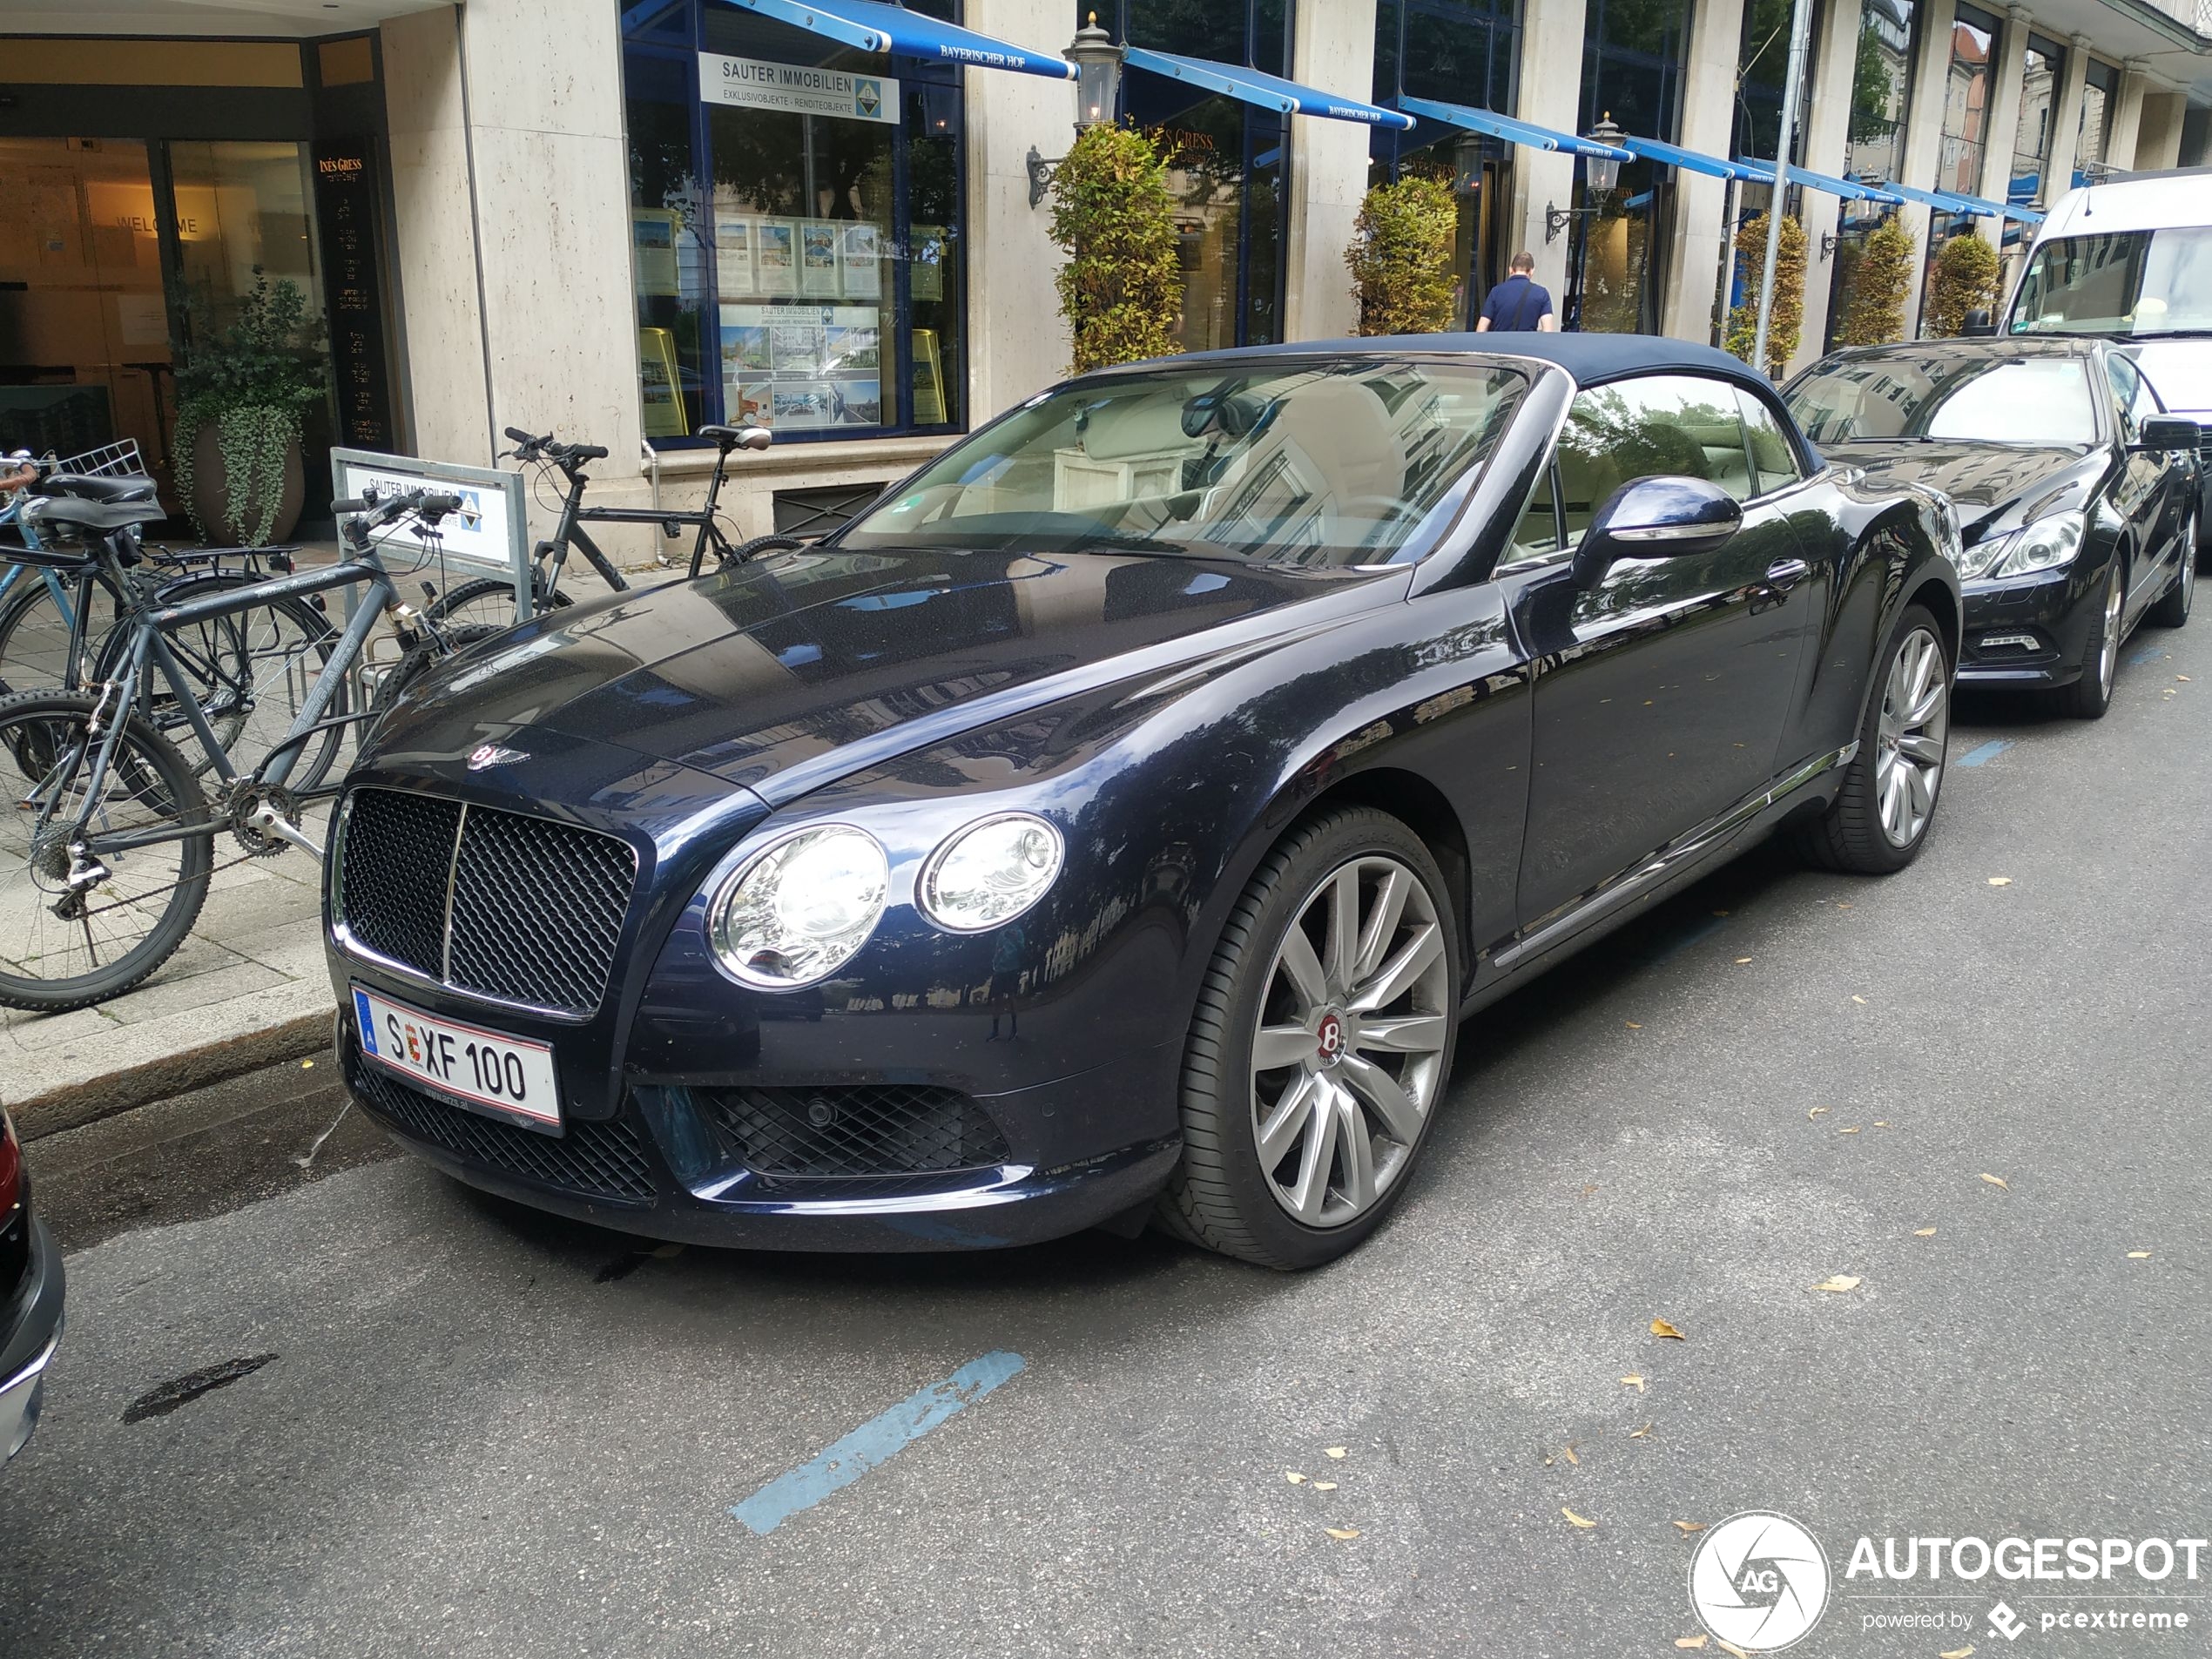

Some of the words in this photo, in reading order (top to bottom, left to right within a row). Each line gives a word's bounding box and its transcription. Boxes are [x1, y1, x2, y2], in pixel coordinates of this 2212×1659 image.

[940, 44, 1005, 65] BAYERISCHER
[1007, 56, 1026, 68] HOF
[723, 62, 775, 84] SAUTER
[779, 70, 852, 92] IMMOBILIEN
[723, 90, 788, 106] EXKLUSIVOBJEKTE
[794, 98, 852, 113] RENDITEOBJEKTE
[1328, 105, 1369, 119] BAYERISCHER
[1369, 112, 1381, 122] HOF
[338, 158, 362, 172] GRESS
[761, 306, 785, 314] SAUTER
[786, 307, 820, 315] IMMOBILIEN
[367, 1030, 374, 1045] A
[387, 1013, 405, 1060] S
[420, 1026, 456, 1080] XF
[465, 1042, 526, 1101] 100
